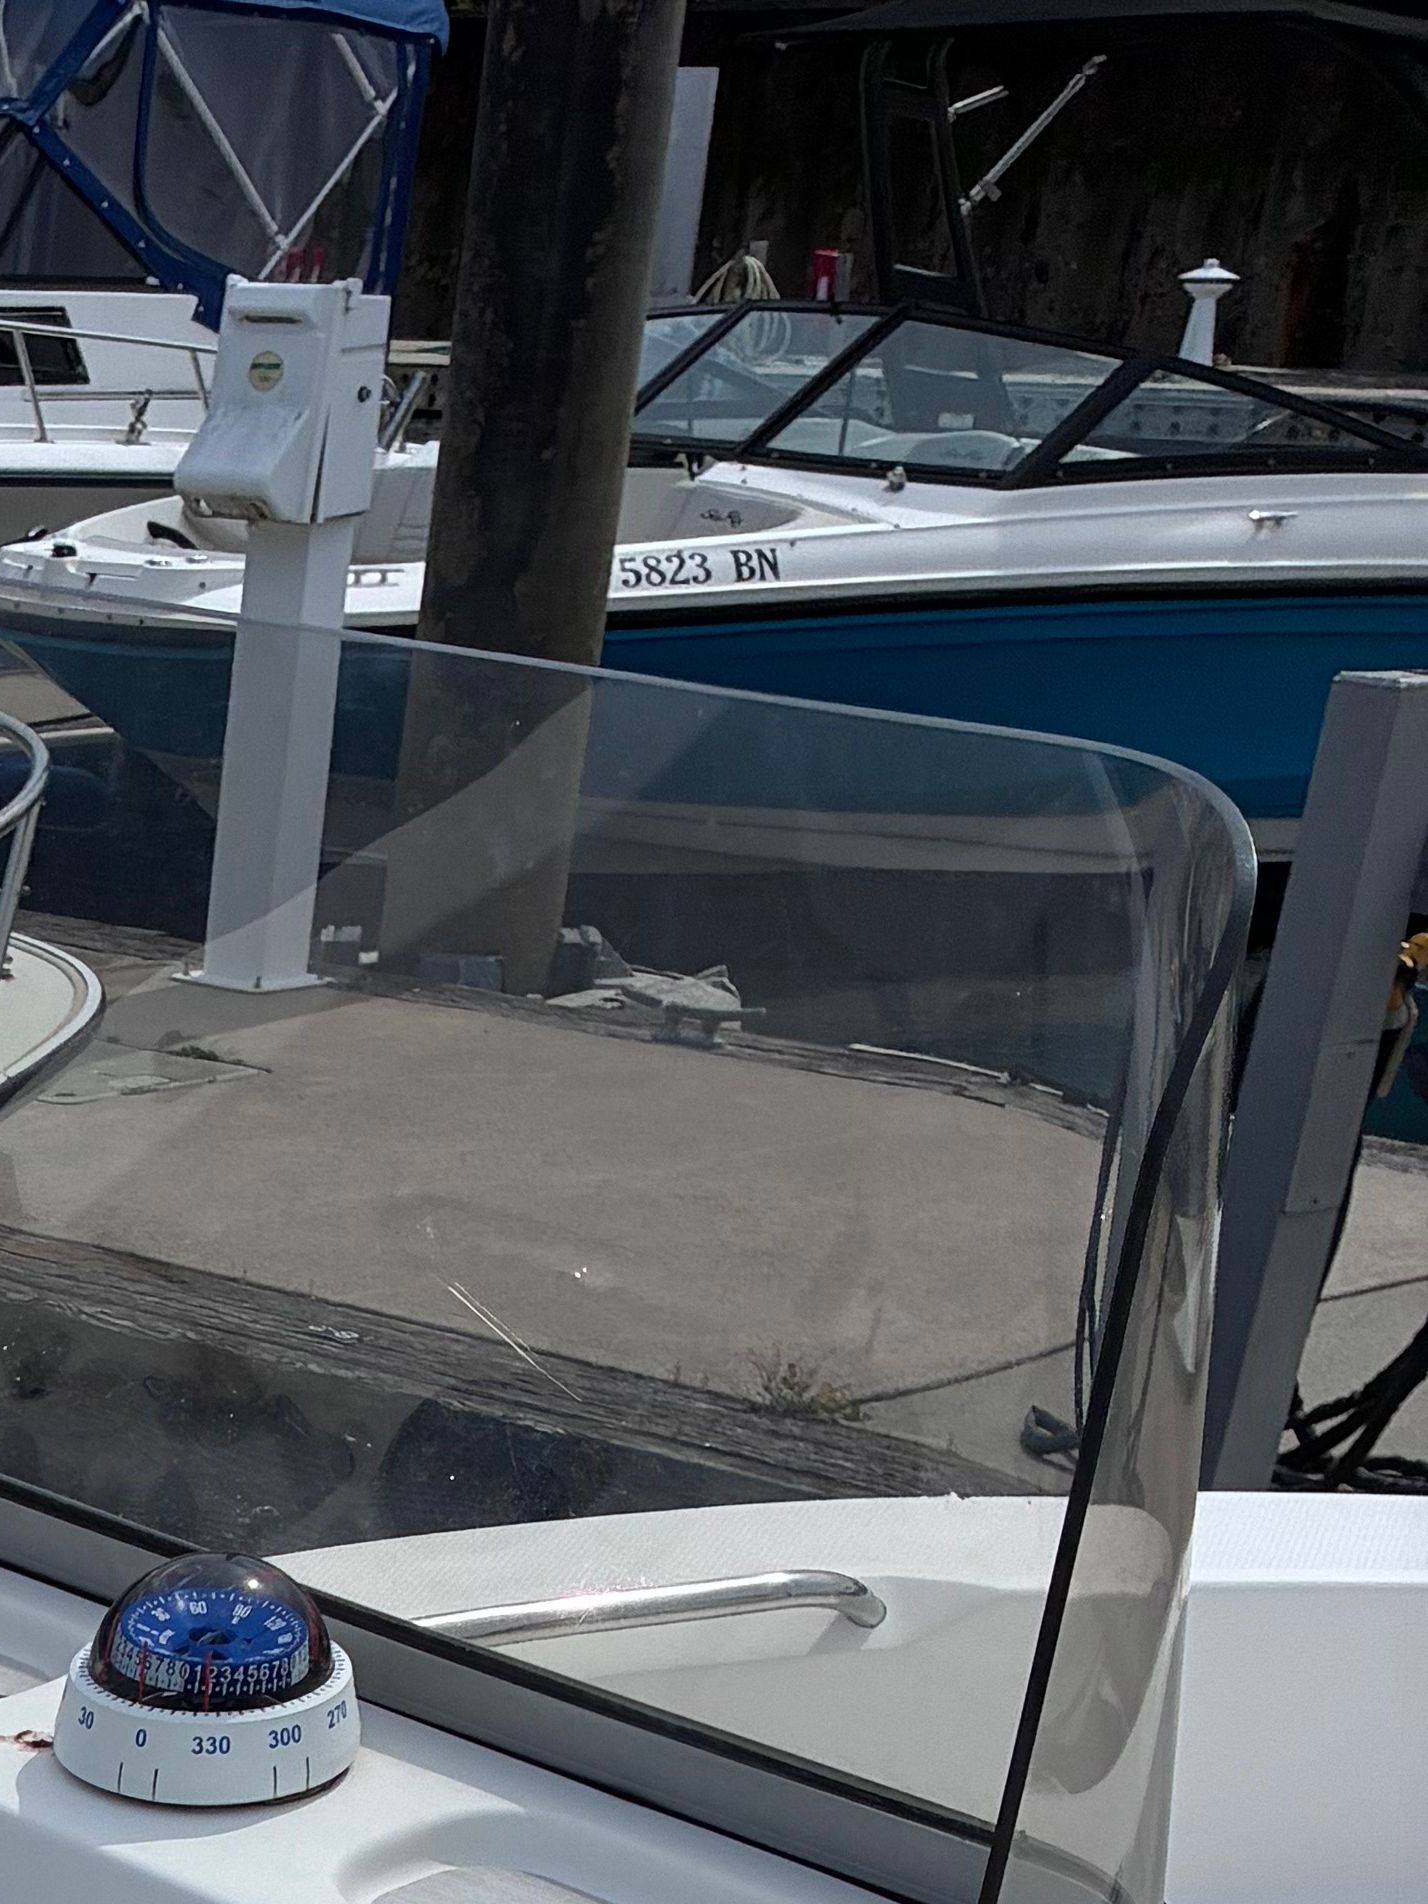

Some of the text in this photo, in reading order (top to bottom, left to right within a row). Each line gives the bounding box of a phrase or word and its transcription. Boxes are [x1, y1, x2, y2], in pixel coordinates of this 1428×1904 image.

[618, 548, 781, 588] 5823 BN
[78, 1706, 95, 1730] 30
[326, 1700, 349, 1729] 270
[135, 1728, 148, 1748] 0
[191, 1735, 232, 1755] 330
[267, 1723, 303, 1749] 300
